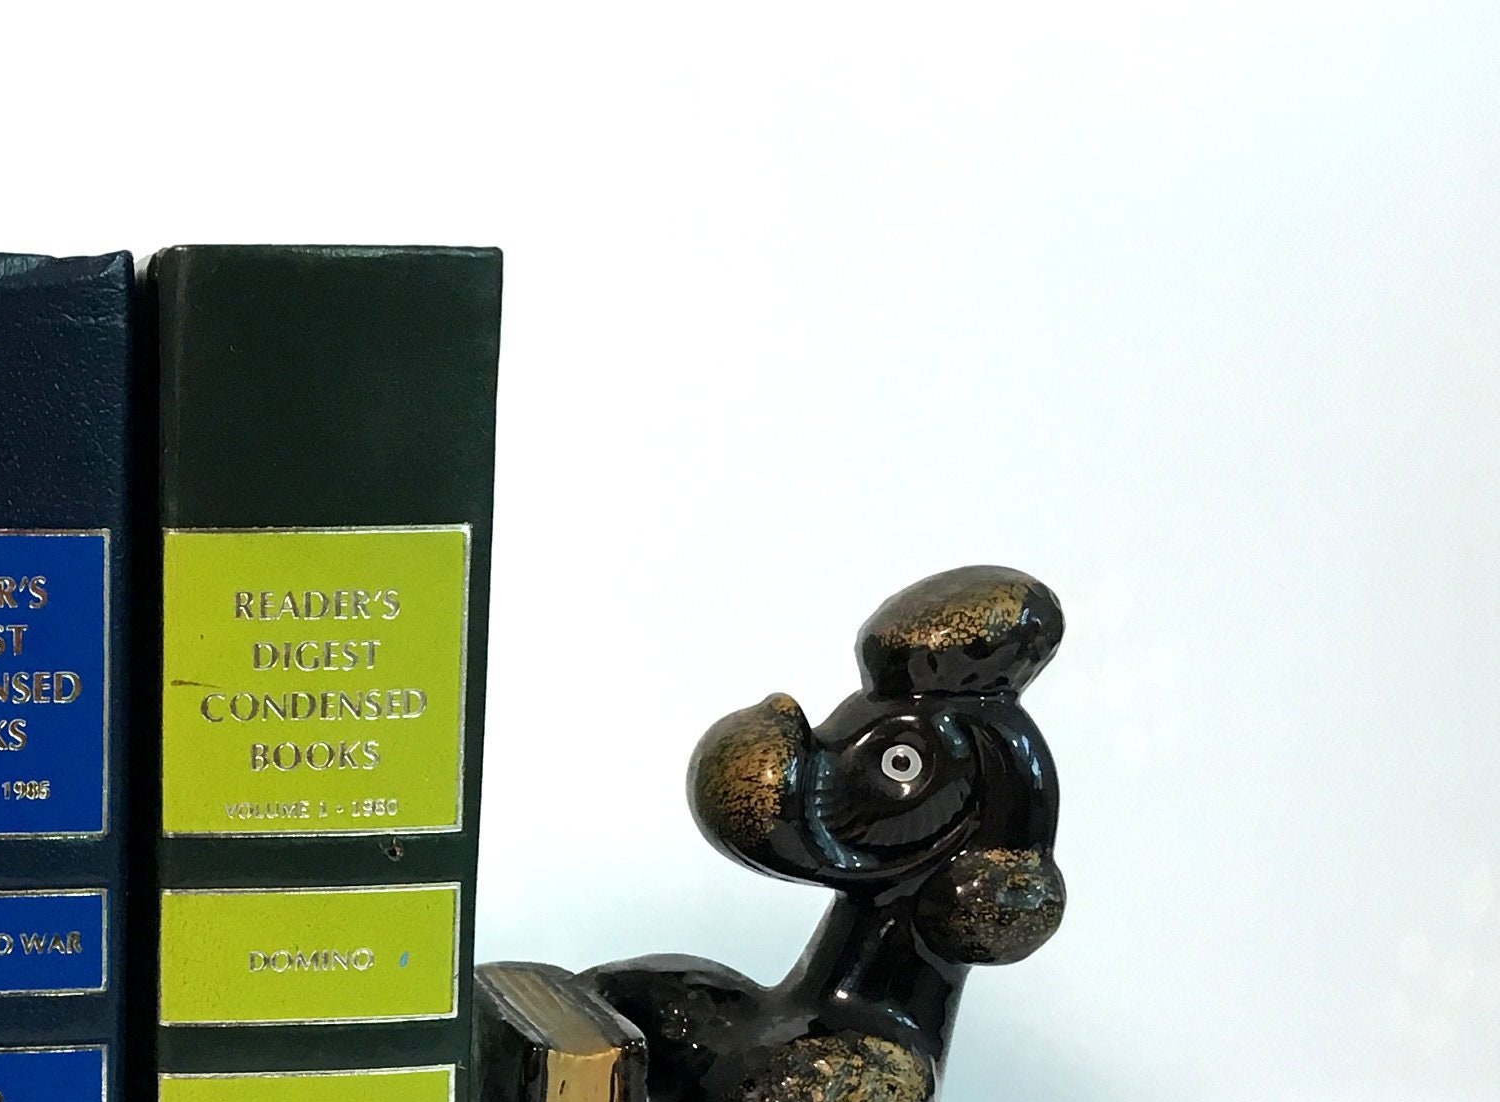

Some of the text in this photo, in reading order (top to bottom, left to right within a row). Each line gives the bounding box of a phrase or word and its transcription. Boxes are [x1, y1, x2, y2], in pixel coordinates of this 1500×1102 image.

[234, 590, 400, 621] READER'S
[252, 640, 381, 671] DIGEST
[200, 689, 427, 722] CONDENSED
[250, 741, 380, 772] BOOKS
[225, 801, 310, 819] VOLUME
[20, 931, 82, 954] WAR
[250, 948, 374, 973] DOMINO
